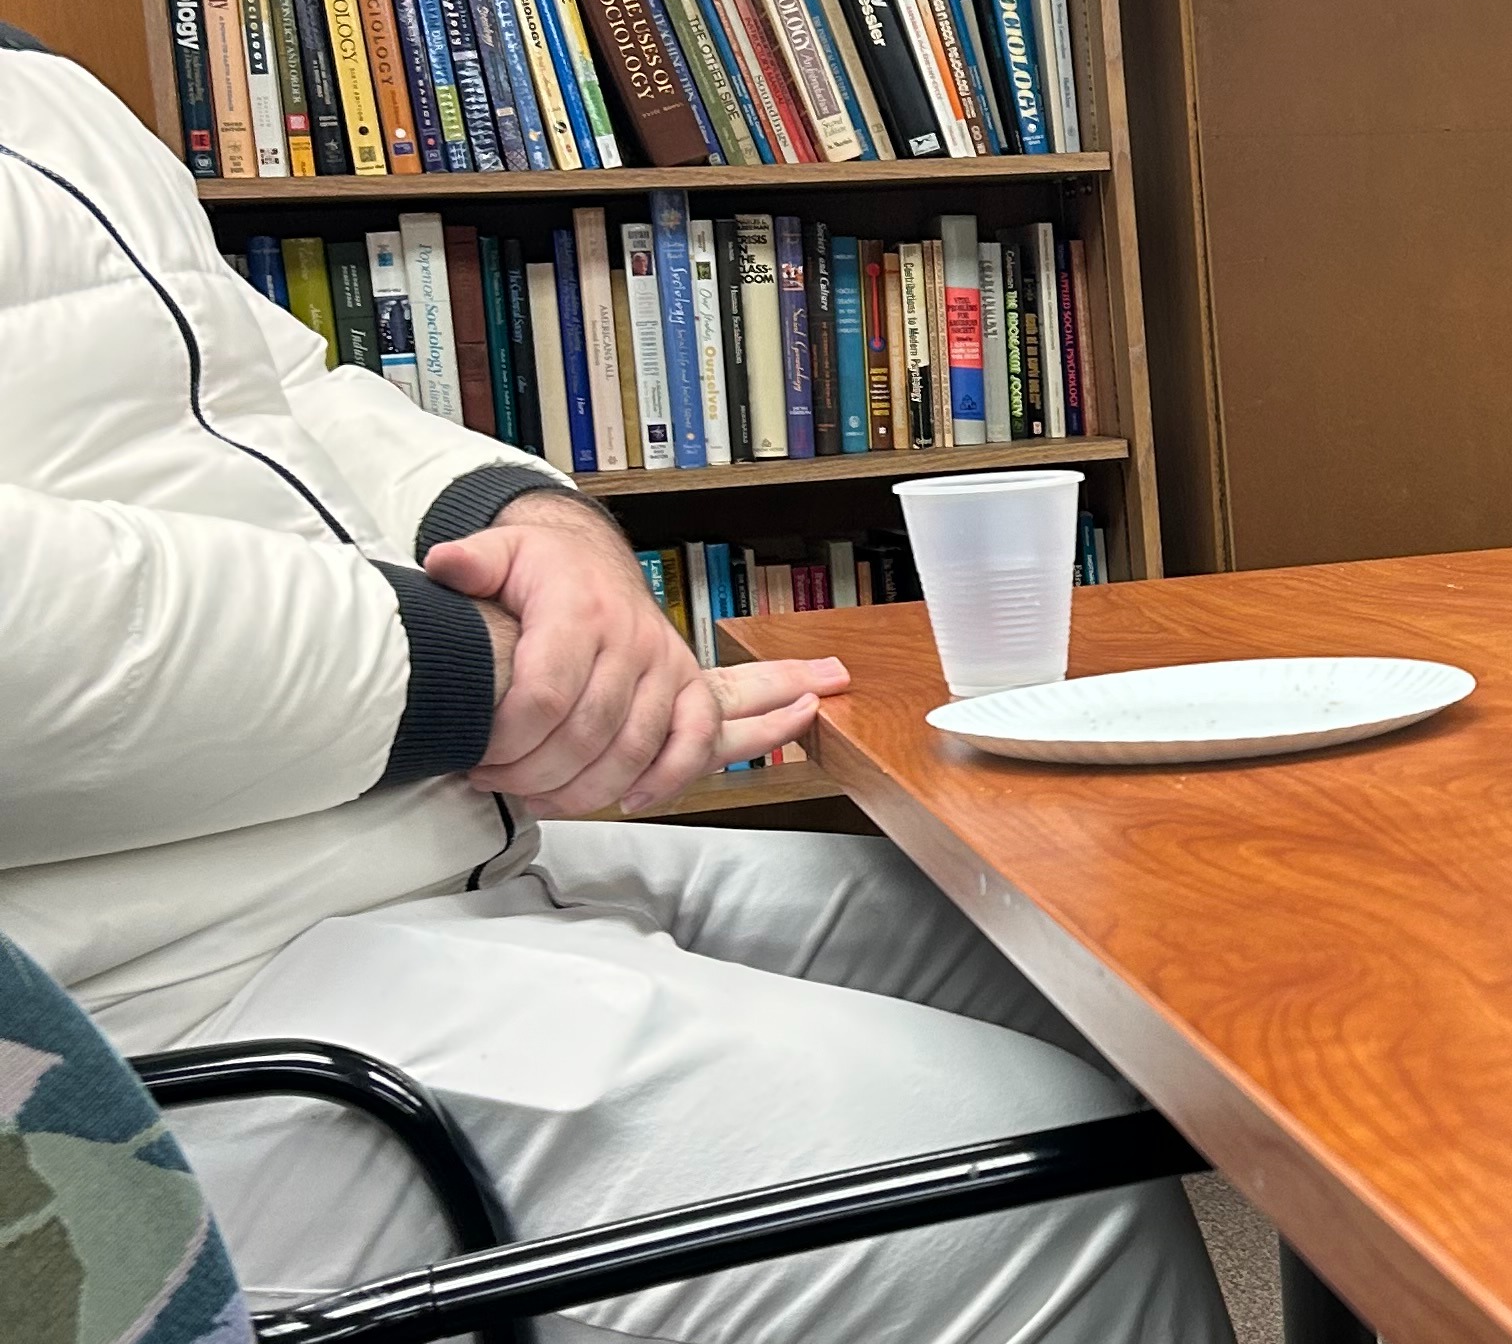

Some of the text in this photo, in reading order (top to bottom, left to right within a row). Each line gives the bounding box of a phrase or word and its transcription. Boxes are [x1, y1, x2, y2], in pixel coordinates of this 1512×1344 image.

[286, 46, 297, 68] AND
[631, 17, 662, 68] USES
[651, 67, 675, 98] OF
[652, 10, 685, 73] TEACHING
[688, 14, 707, 42] THE
[699, 42, 728, 90] OTHER
[720, 90, 740, 122] SIDE
[800, 51, 814, 67] An
[290, 68, 302, 103] ORDER
[753, 73, 790, 149] Soundings
[805, 65, 833, 115] Introduction
[666, 265, 691, 324] Sociology
[699, 287, 713, 310] Our
[815, 221, 830, 310] Society and Culture
[416, 243, 445, 377] Popenoe Sociology
[599, 304, 613, 379] AMERICANS ALL
[729, 285, 743, 364] Human Socialization
[904, 262, 922, 402] Contributions to Modern Psychology
[1005, 250, 1023, 416] Coleman THE ADOLESCENT SOCIETY
[1058, 271, 1078, 407] APPLIED SOCIAL PSYCHOLOGY
[438, 380, 454, 416] fourth
[703, 345, 721, 420] Ourselves
